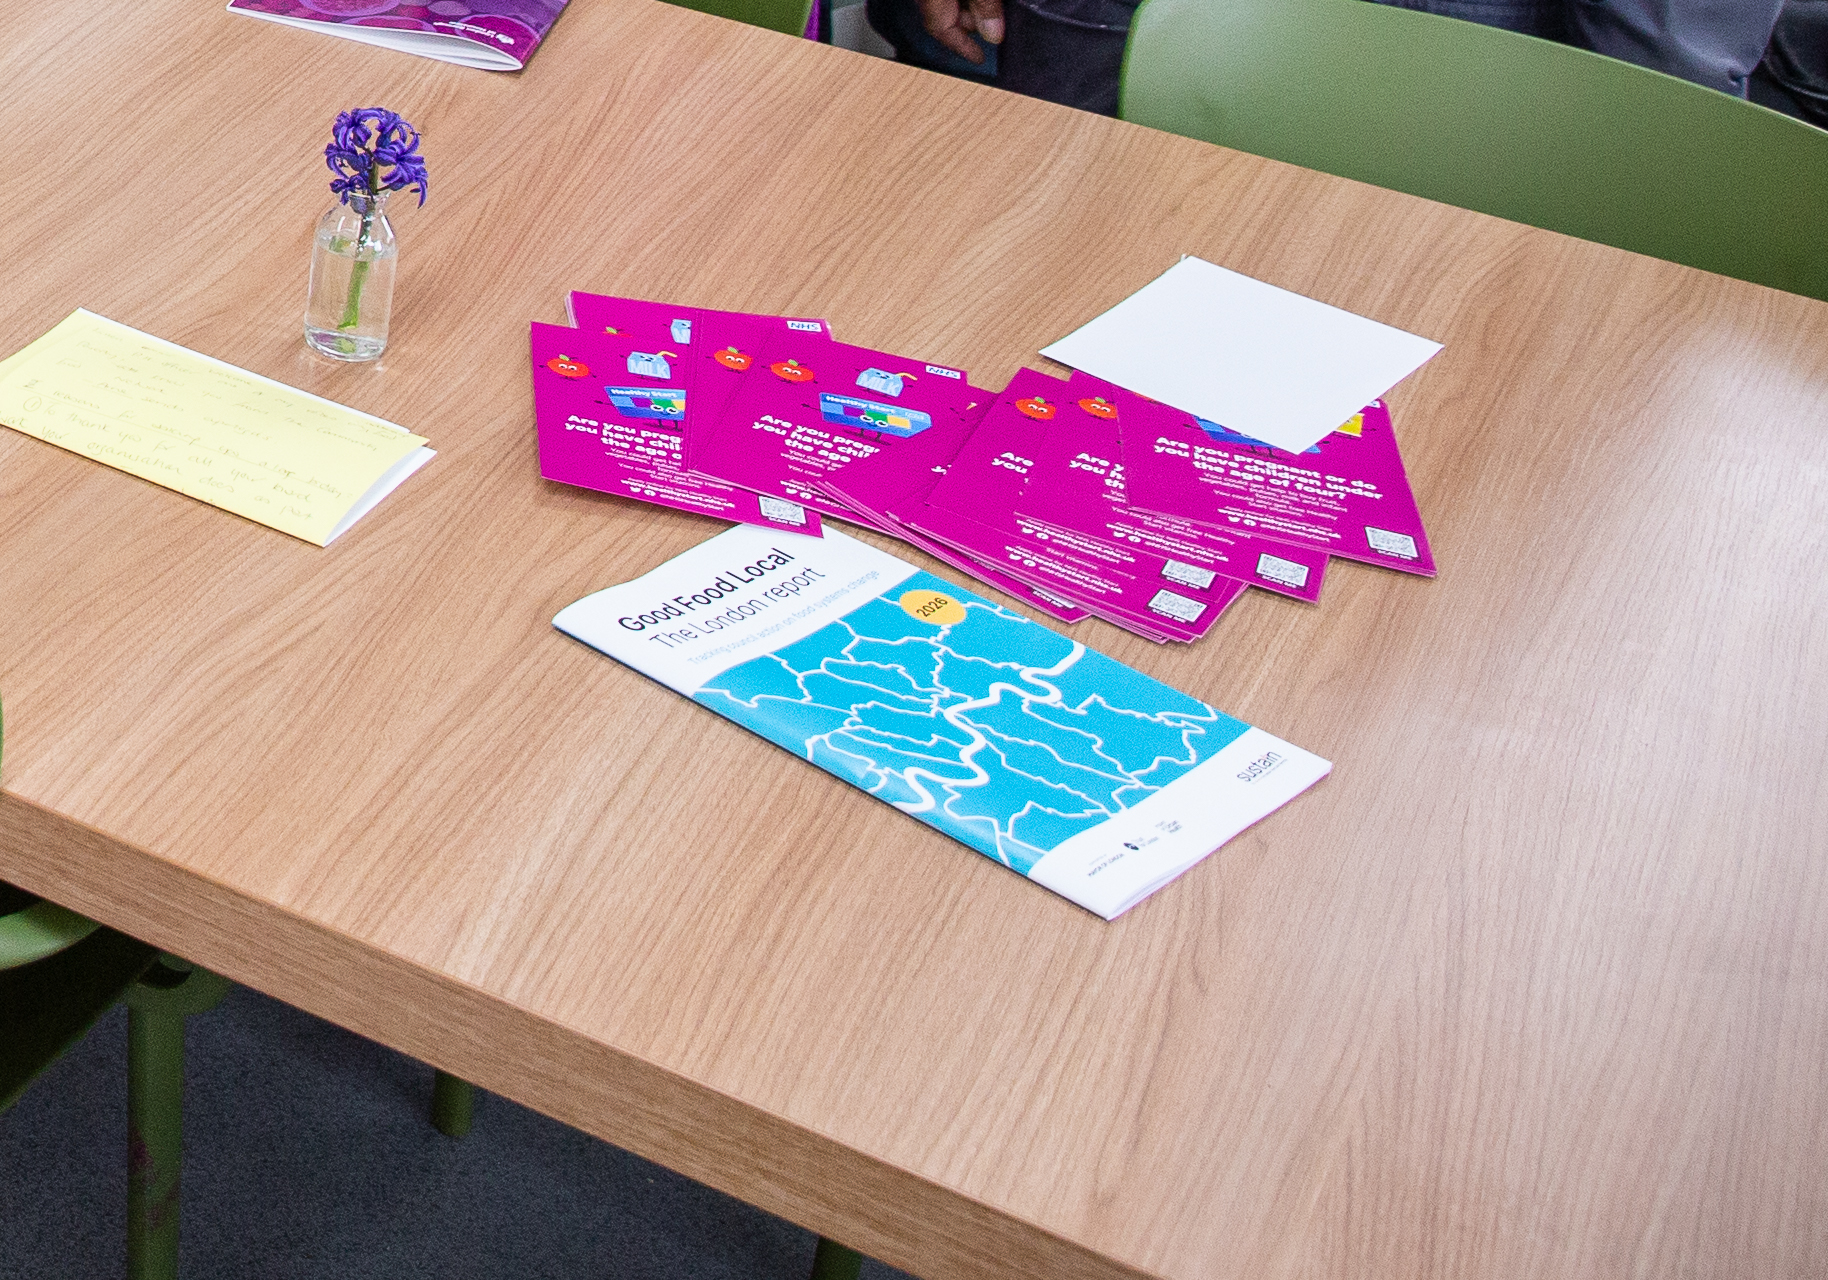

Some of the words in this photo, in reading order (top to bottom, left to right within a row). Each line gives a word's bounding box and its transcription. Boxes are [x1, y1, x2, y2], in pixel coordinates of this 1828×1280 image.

[789, 321, 820, 332] NHS
[630, 358, 669, 377] MILK
[928, 366, 959, 379] NHS
[610, 387, 651, 399] Healthy
[651, 389, 678, 399] Start
[860, 374, 900, 392] MILK
[825, 394, 869, 410] Healthy
[868, 403, 896, 414] Start
[1154, 436, 1190, 450] Are
[1194, 445, 1230, 459] you
[1233, 454, 1322, 480] pregnant
[1324, 474, 1347, 484] or
[1350, 480, 1377, 491] do
[1154, 445, 1190, 458] you
[1194, 452, 1240, 469] have
[1243, 463, 1322, 488] children
[1325, 483, 1384, 500] under
[1193, 460, 1225, 475] the
[1229, 468, 1265, 482] age
[1268, 477, 1291, 489] of
[617, 601, 686, 633] Good
[672, 570, 739, 612] Food
[727, 546, 796, 585] Local
[648, 623, 698, 648] The
[693, 595, 770, 636] London
[762, 565, 827, 603] report
[687, 642, 729, 667] Tracking
[726, 629, 758, 653] council
[753, 618, 785, 640] action
[782, 612, 797, 627] on
[794, 601, 816, 621] food
[812, 586, 850, 612] systems
[846, 568, 881, 593] change
[915, 596, 949, 619] 2026
[1236, 750, 1283, 783] sustain
